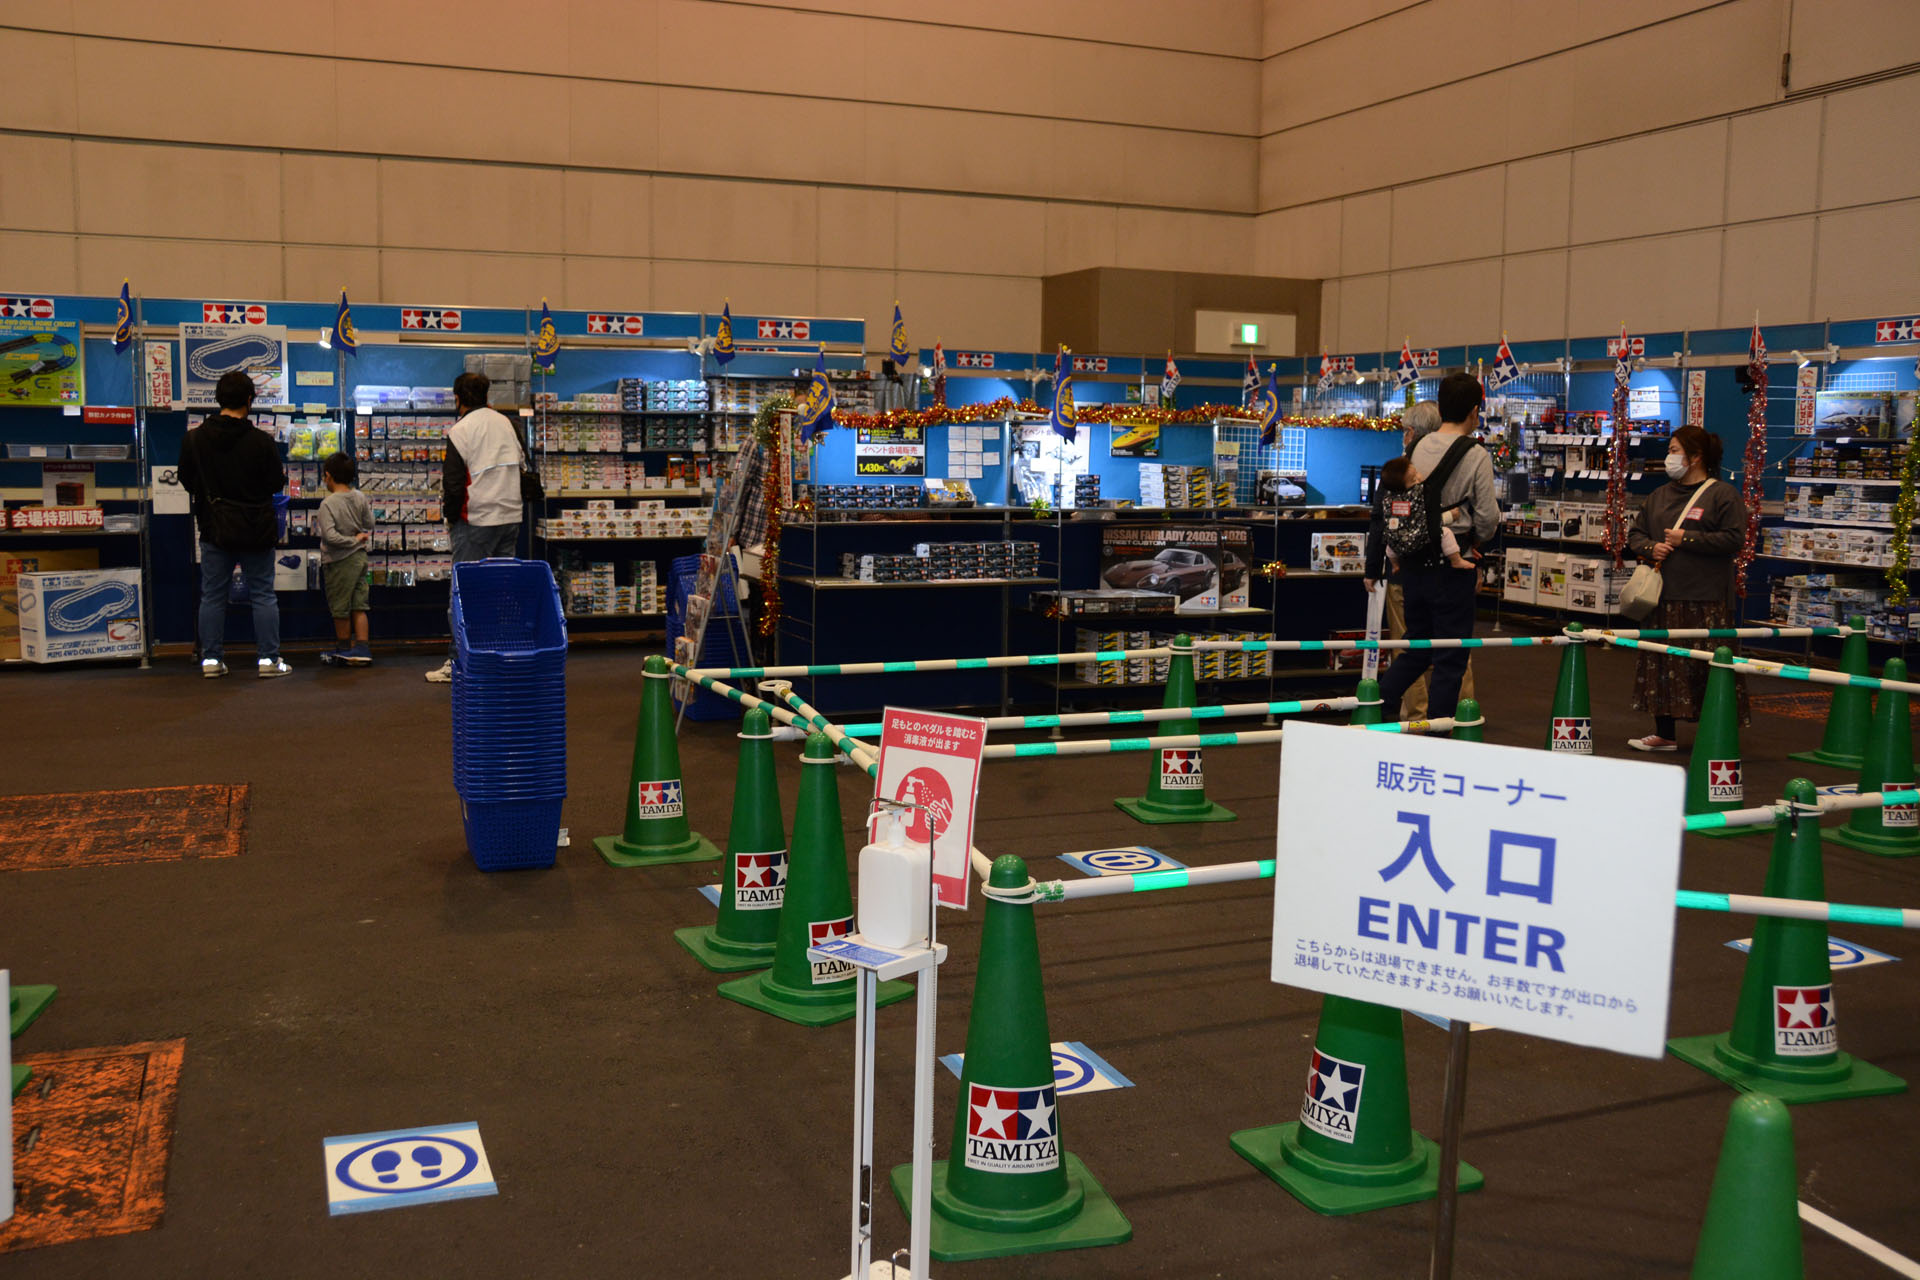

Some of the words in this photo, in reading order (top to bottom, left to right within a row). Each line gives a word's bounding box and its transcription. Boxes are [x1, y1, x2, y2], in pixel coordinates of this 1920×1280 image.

[12, 510, 103, 527] 会場特別販売
[1103, 529, 1139, 541] NISSAN
[1140, 530, 1185, 541] FAIRLADY
[1186, 530, 1218, 542] 240ZG
[891, 718, 977, 740] 足もとのペダルを踏むと
[903, 733, 961, 751] 消毒液が出ます
[1375, 761, 1568, 806] 販売コーナー
[641, 804, 682, 815] TAMIYA
[1377, 810, 1557, 905] 入口
[1357, 896, 1567, 974] ENTER
[1294, 952, 1574, 1020] 退場していただきますようお願いいたします。
[1295, 938, 1638, 1014] こちらからは退場できません。お手数ですが出口から
[968, 1138, 1058, 1162] TAMIYA
